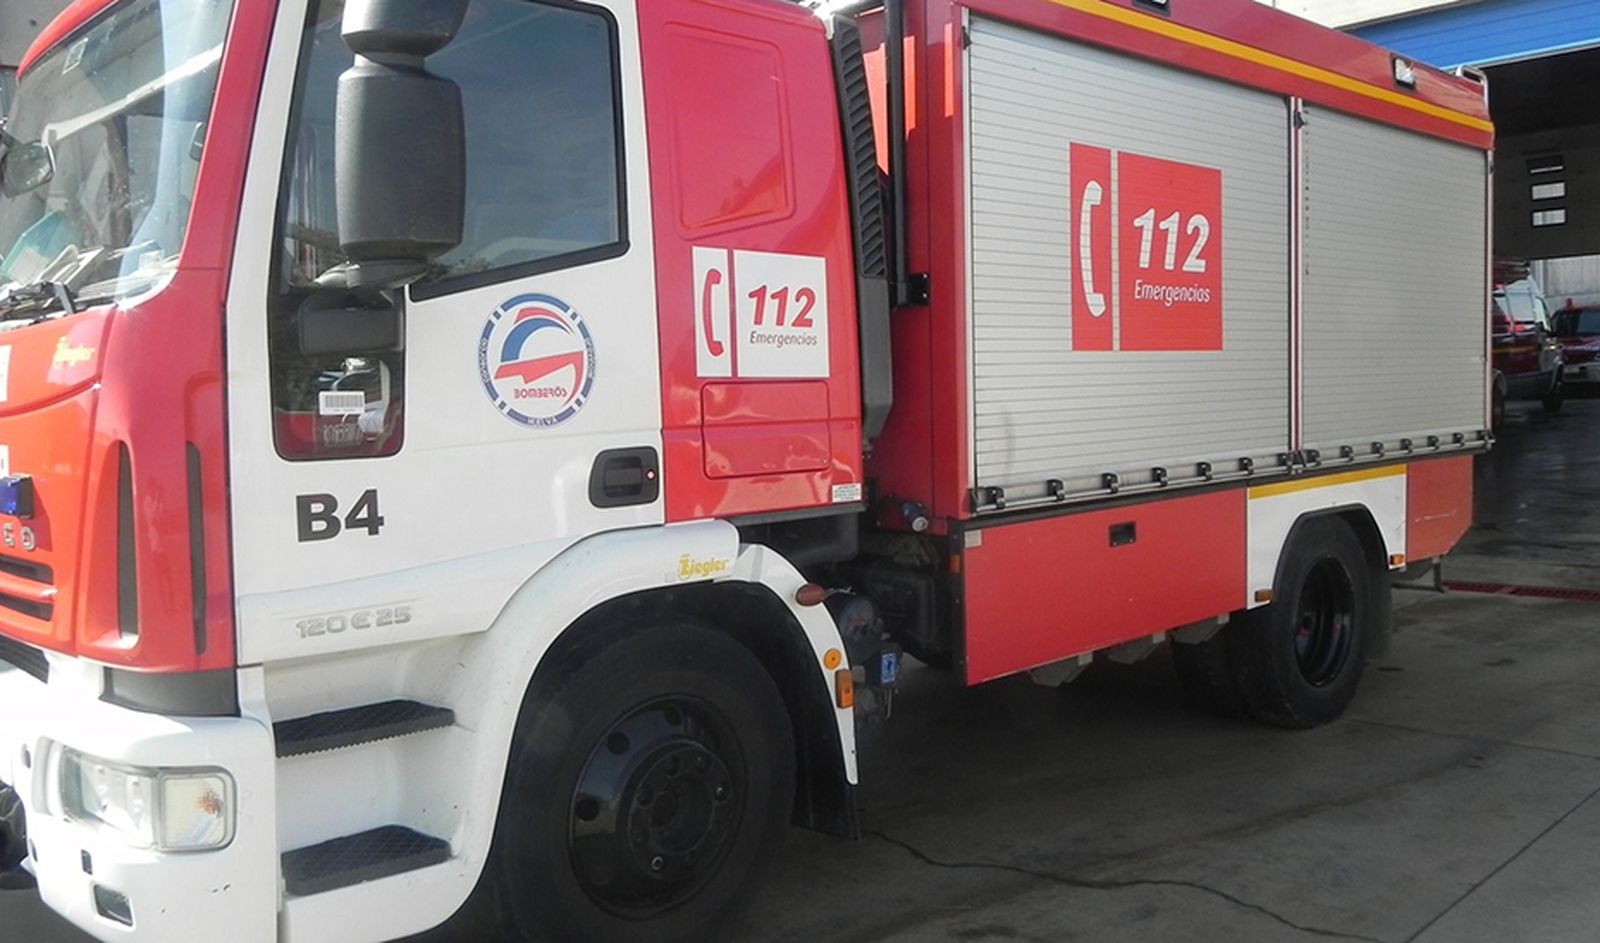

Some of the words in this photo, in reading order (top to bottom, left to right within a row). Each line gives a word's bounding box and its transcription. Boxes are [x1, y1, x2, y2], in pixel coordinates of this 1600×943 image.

[1133, 208, 1210, 273] 112
[748, 285, 816, 328] 112
[1134, 279, 1210, 308] Emergencias
[750, 330, 818, 348] Emergencias
[295, 488, 385, 543] B4
